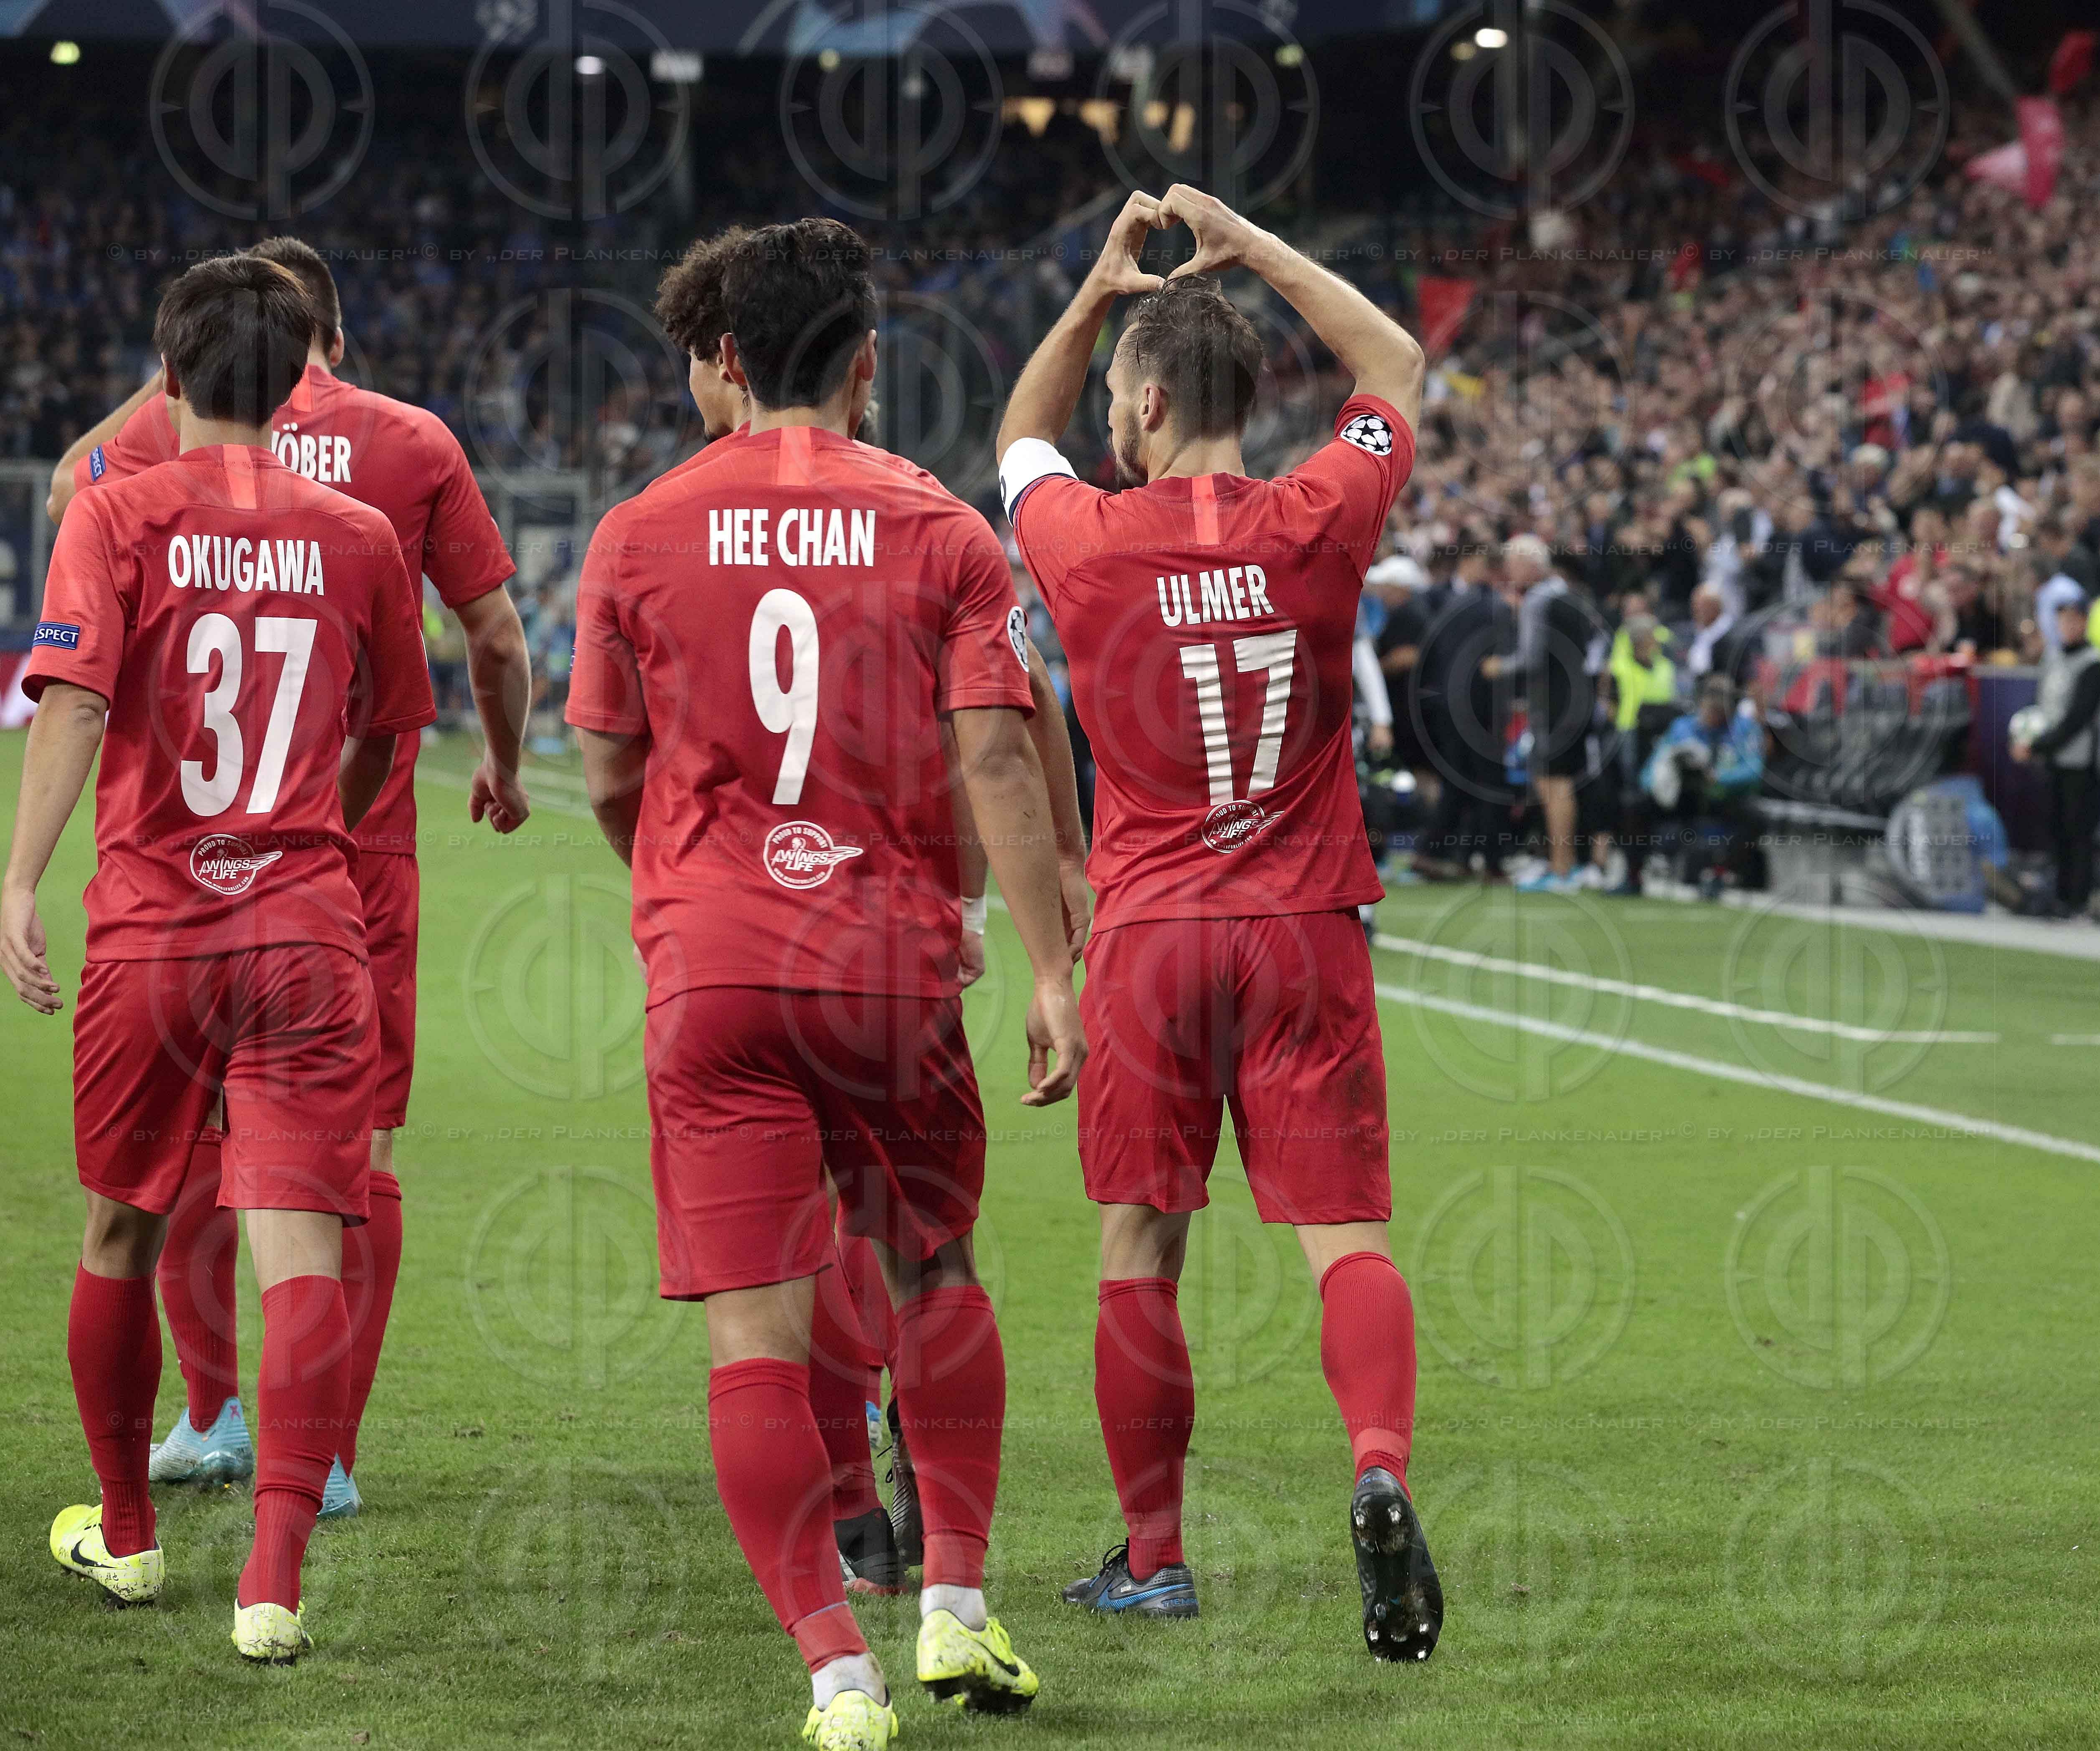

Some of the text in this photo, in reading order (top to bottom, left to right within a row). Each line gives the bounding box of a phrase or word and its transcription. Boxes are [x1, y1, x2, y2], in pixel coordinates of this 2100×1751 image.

[168, 534, 324, 596] OKUGAWA
[709, 508, 875, 567] HEE CHAN
[1157, 565, 1275, 627] ULMER
[180, 613, 317, 816] 37
[749, 589, 819, 804] 9
[1179, 630, 1297, 806] 17
[198, 840, 216, 856] PROUD
[206, 857, 251, 869] WINGS
[212, 869, 239, 880] LIFE
[782, 849, 829, 863] WINGS
[785, 862, 814, 872] LIFE
